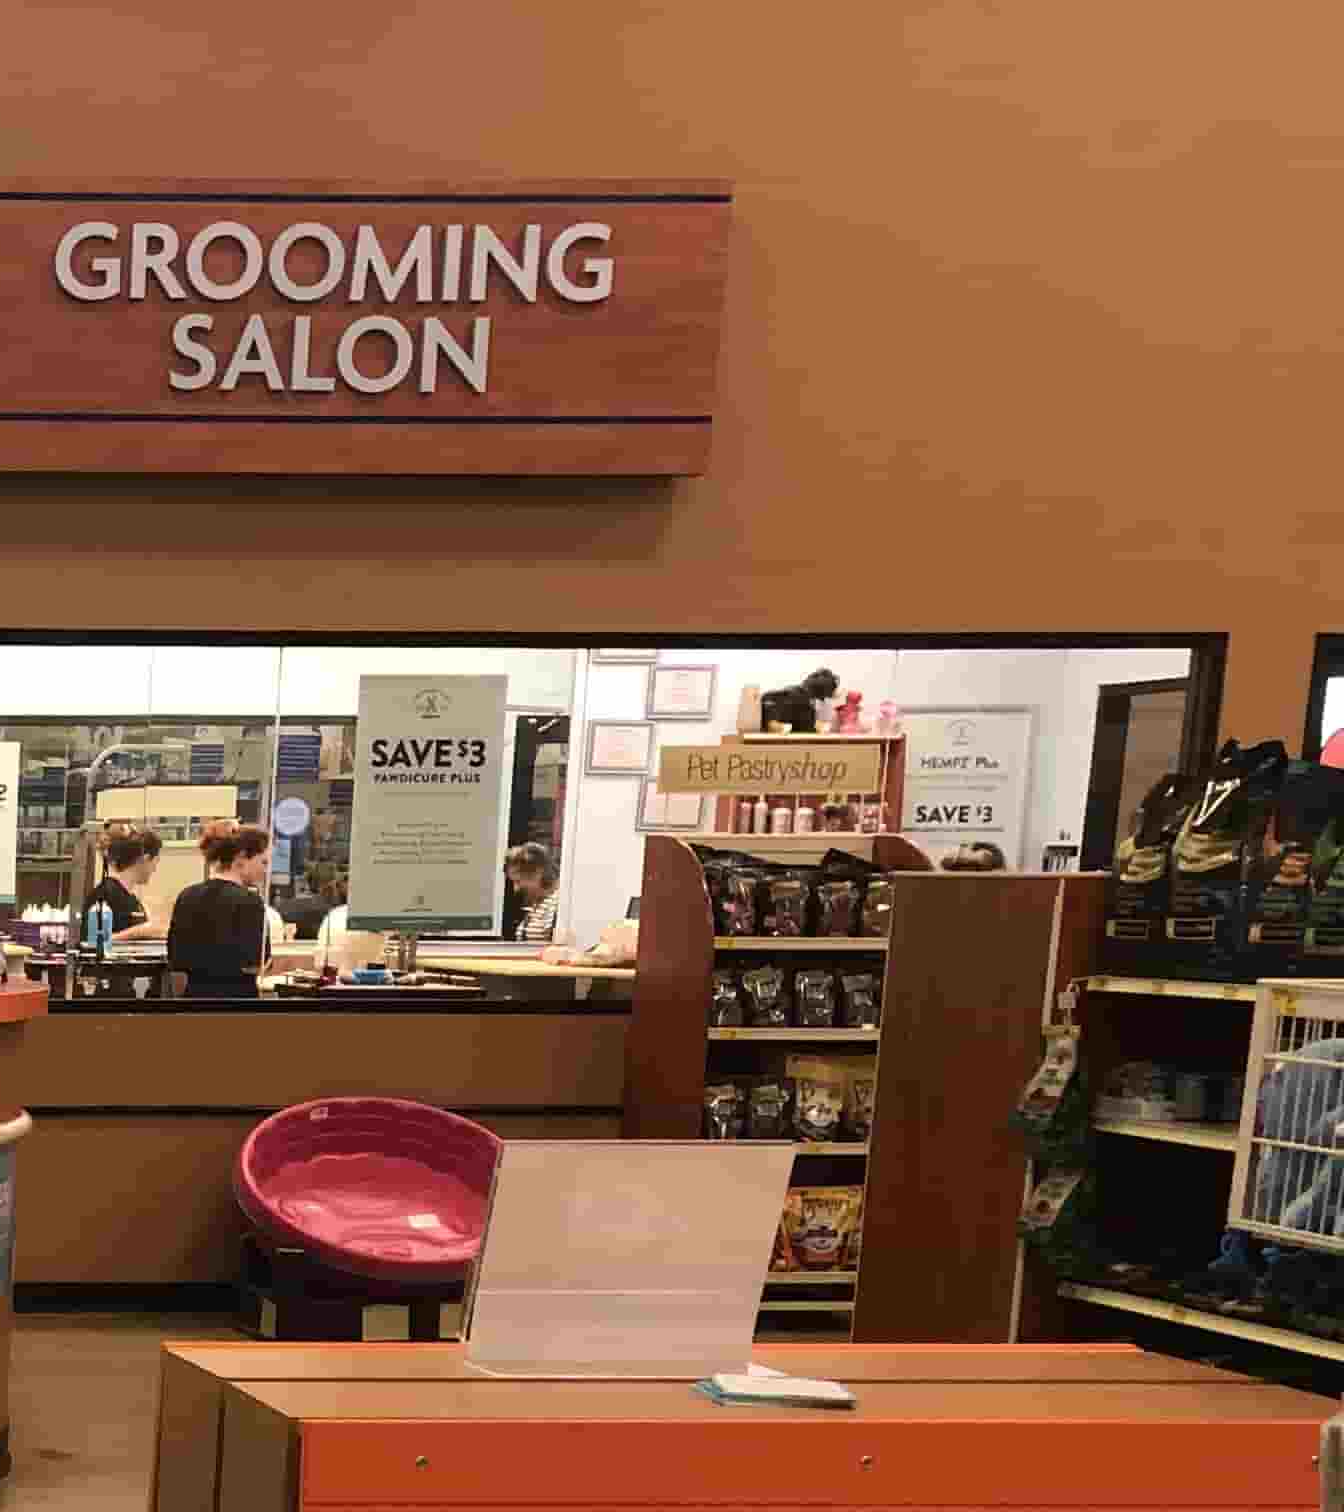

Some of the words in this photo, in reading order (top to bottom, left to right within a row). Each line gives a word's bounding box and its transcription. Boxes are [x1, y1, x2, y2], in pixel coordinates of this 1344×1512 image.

[55, 221, 615, 305] GROOMING
[168, 314, 492, 395] SALON
[370, 738, 454, 768] SAVE
[457, 738, 487, 768] $3
[687, 752, 719, 782] Pet
[728, 751, 848, 788] Pastryshop
[374, 772, 448, 785] PAWDICURE
[450, 772, 481, 784] PLUS
[914, 804, 971, 824] SAVE
